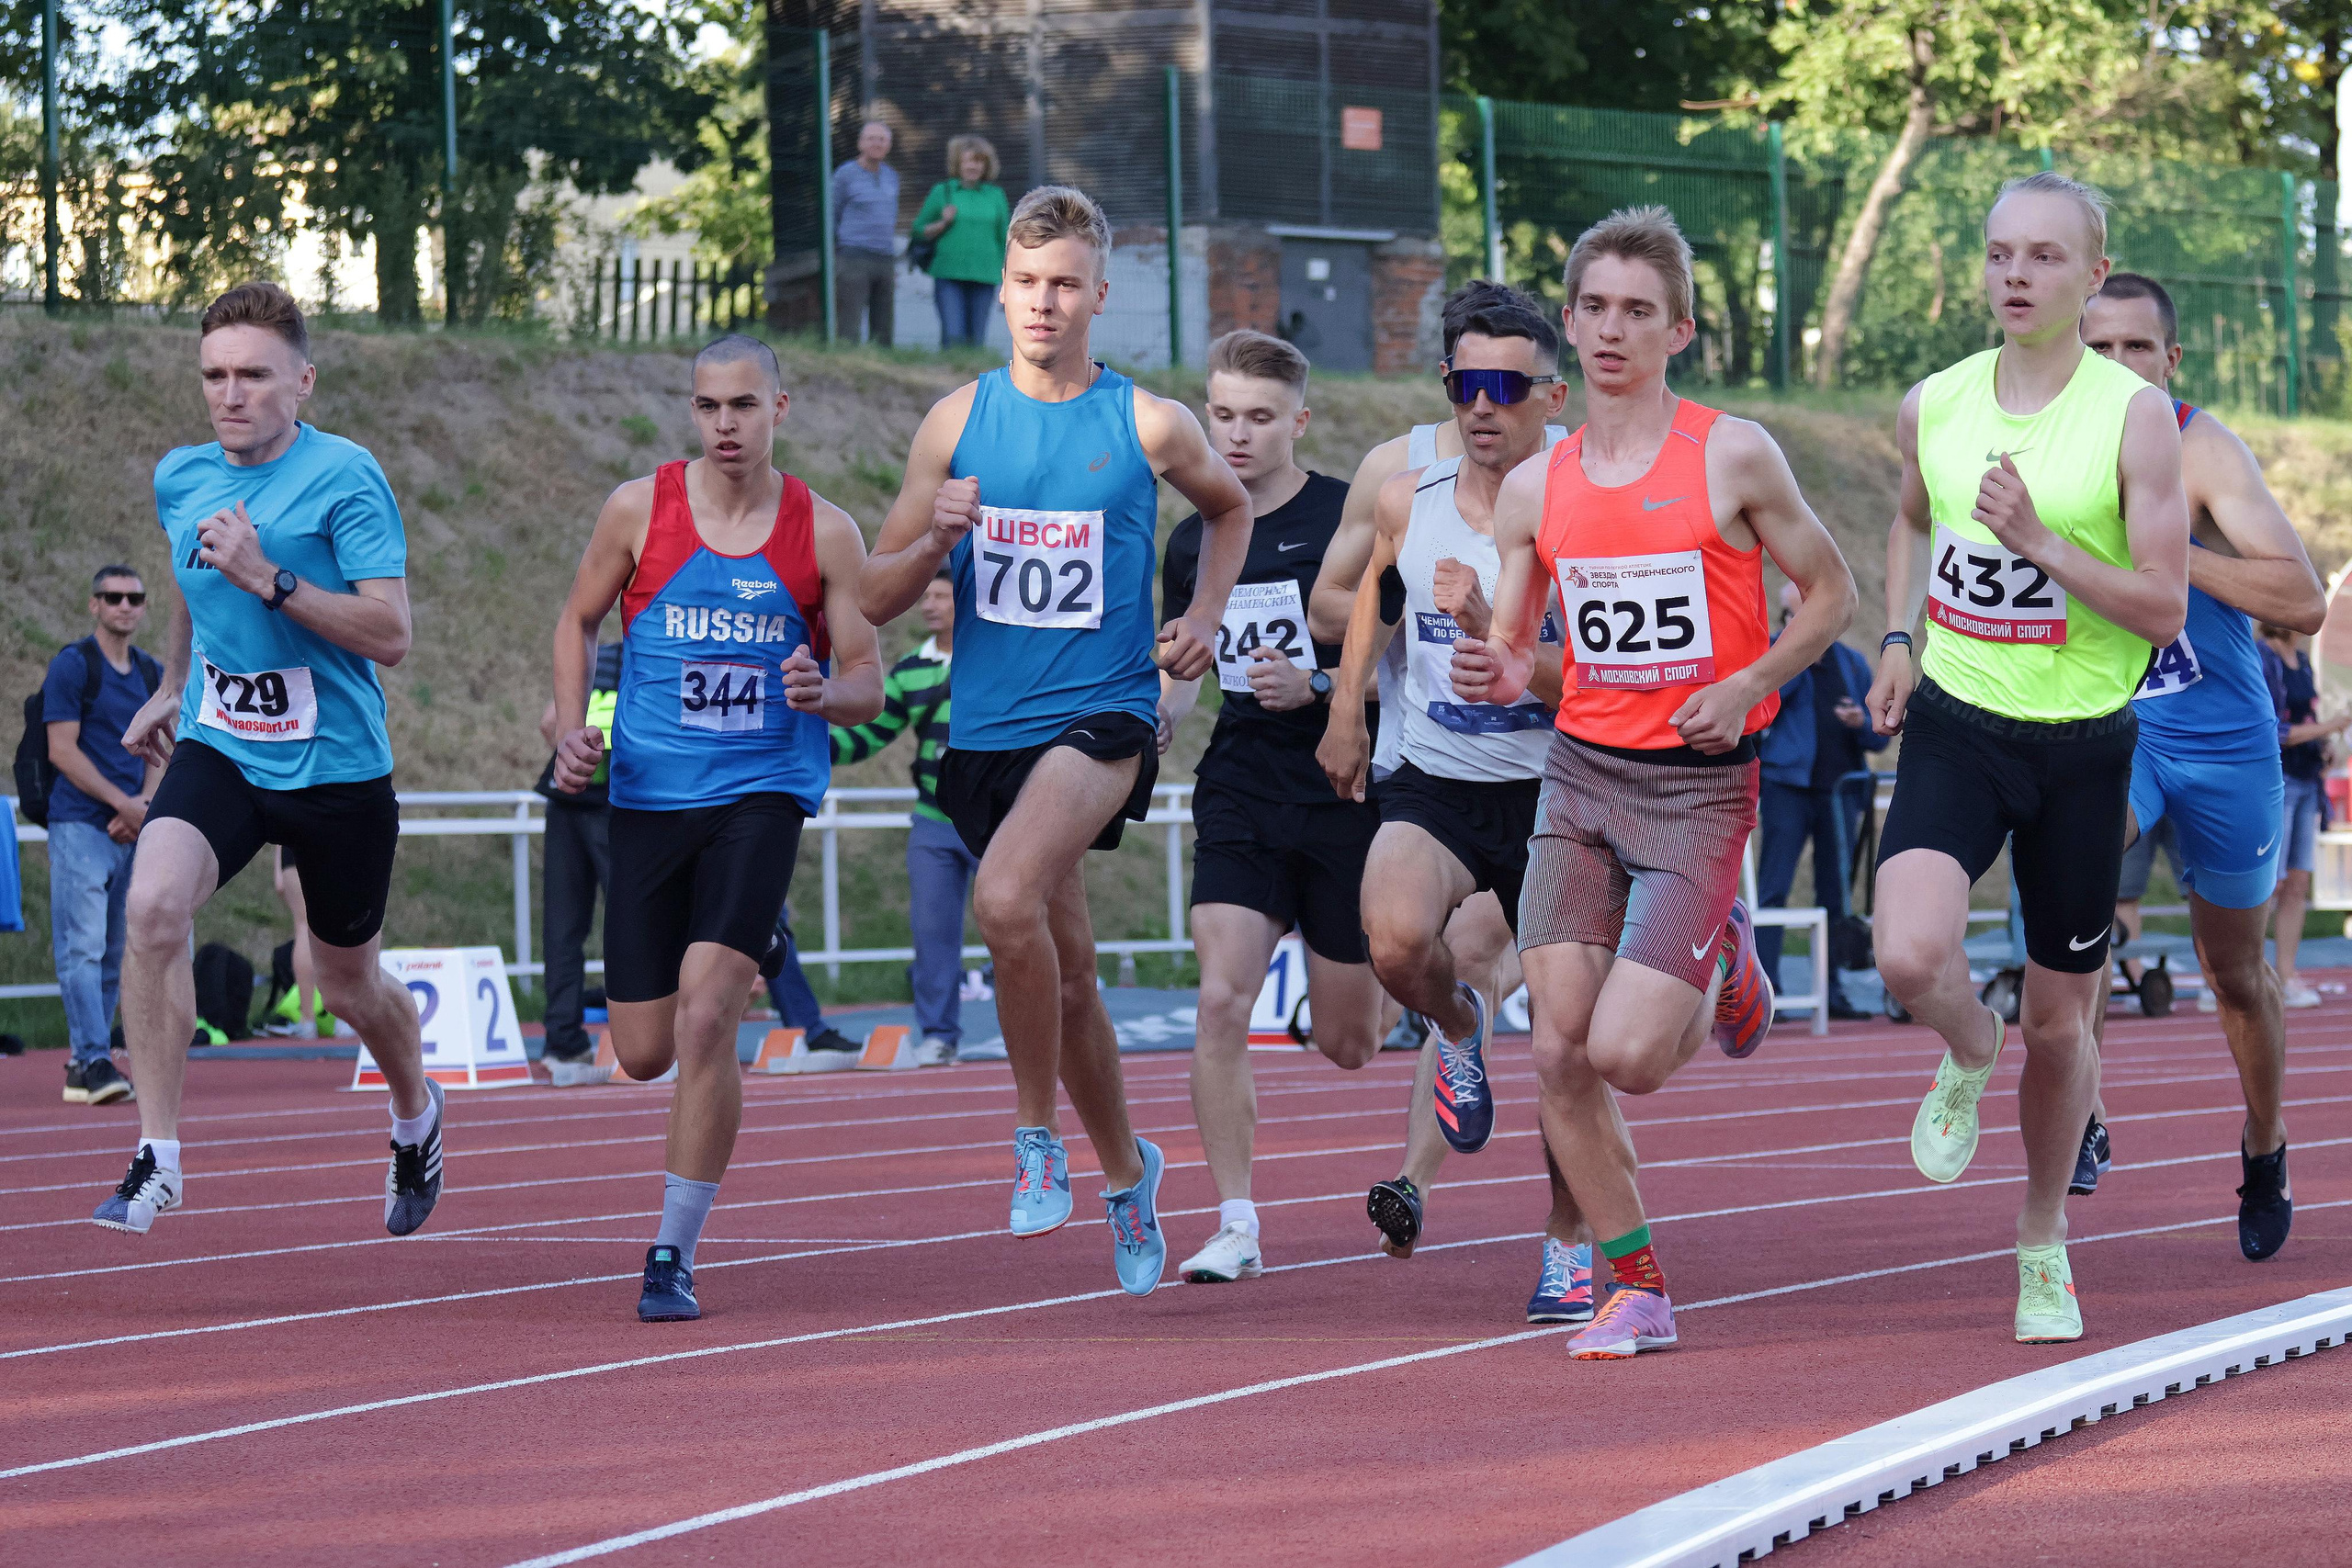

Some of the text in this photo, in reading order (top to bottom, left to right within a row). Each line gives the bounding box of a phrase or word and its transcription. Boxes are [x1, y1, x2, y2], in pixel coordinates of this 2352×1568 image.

[987, 516, 1090, 548] ШВСМ
[731, 578, 777, 590] Reebok
[983, 550, 1093, 614] 702
[1590, 565, 1696, 580] ЗВЕЗДЫ СТУДЕНЧЕСКОГО
[1591, 581, 1619, 589] СПОРТА
[1937, 543, 2053, 608] 432
[664, 603, 787, 643] RUSSIA
[1225, 593, 1297, 610] НАМЕНСКИХ
[1216, 618, 1305, 664] 242
[1433, 627, 1447, 638] ПО
[1577, 595, 1695, 653] 625
[1948, 612, 2052, 638] МОСКОВСКИЙ СПОРТ
[206, 663, 289, 716] 229
[683, 671, 759, 717] 344
[1600, 664, 1699, 684] МОСКОВСКИЙ СПОРТ
[1268, 951, 1288, 1018] 1
[406, 981, 439, 1054] 2
[478, 978, 507, 1051] 2
